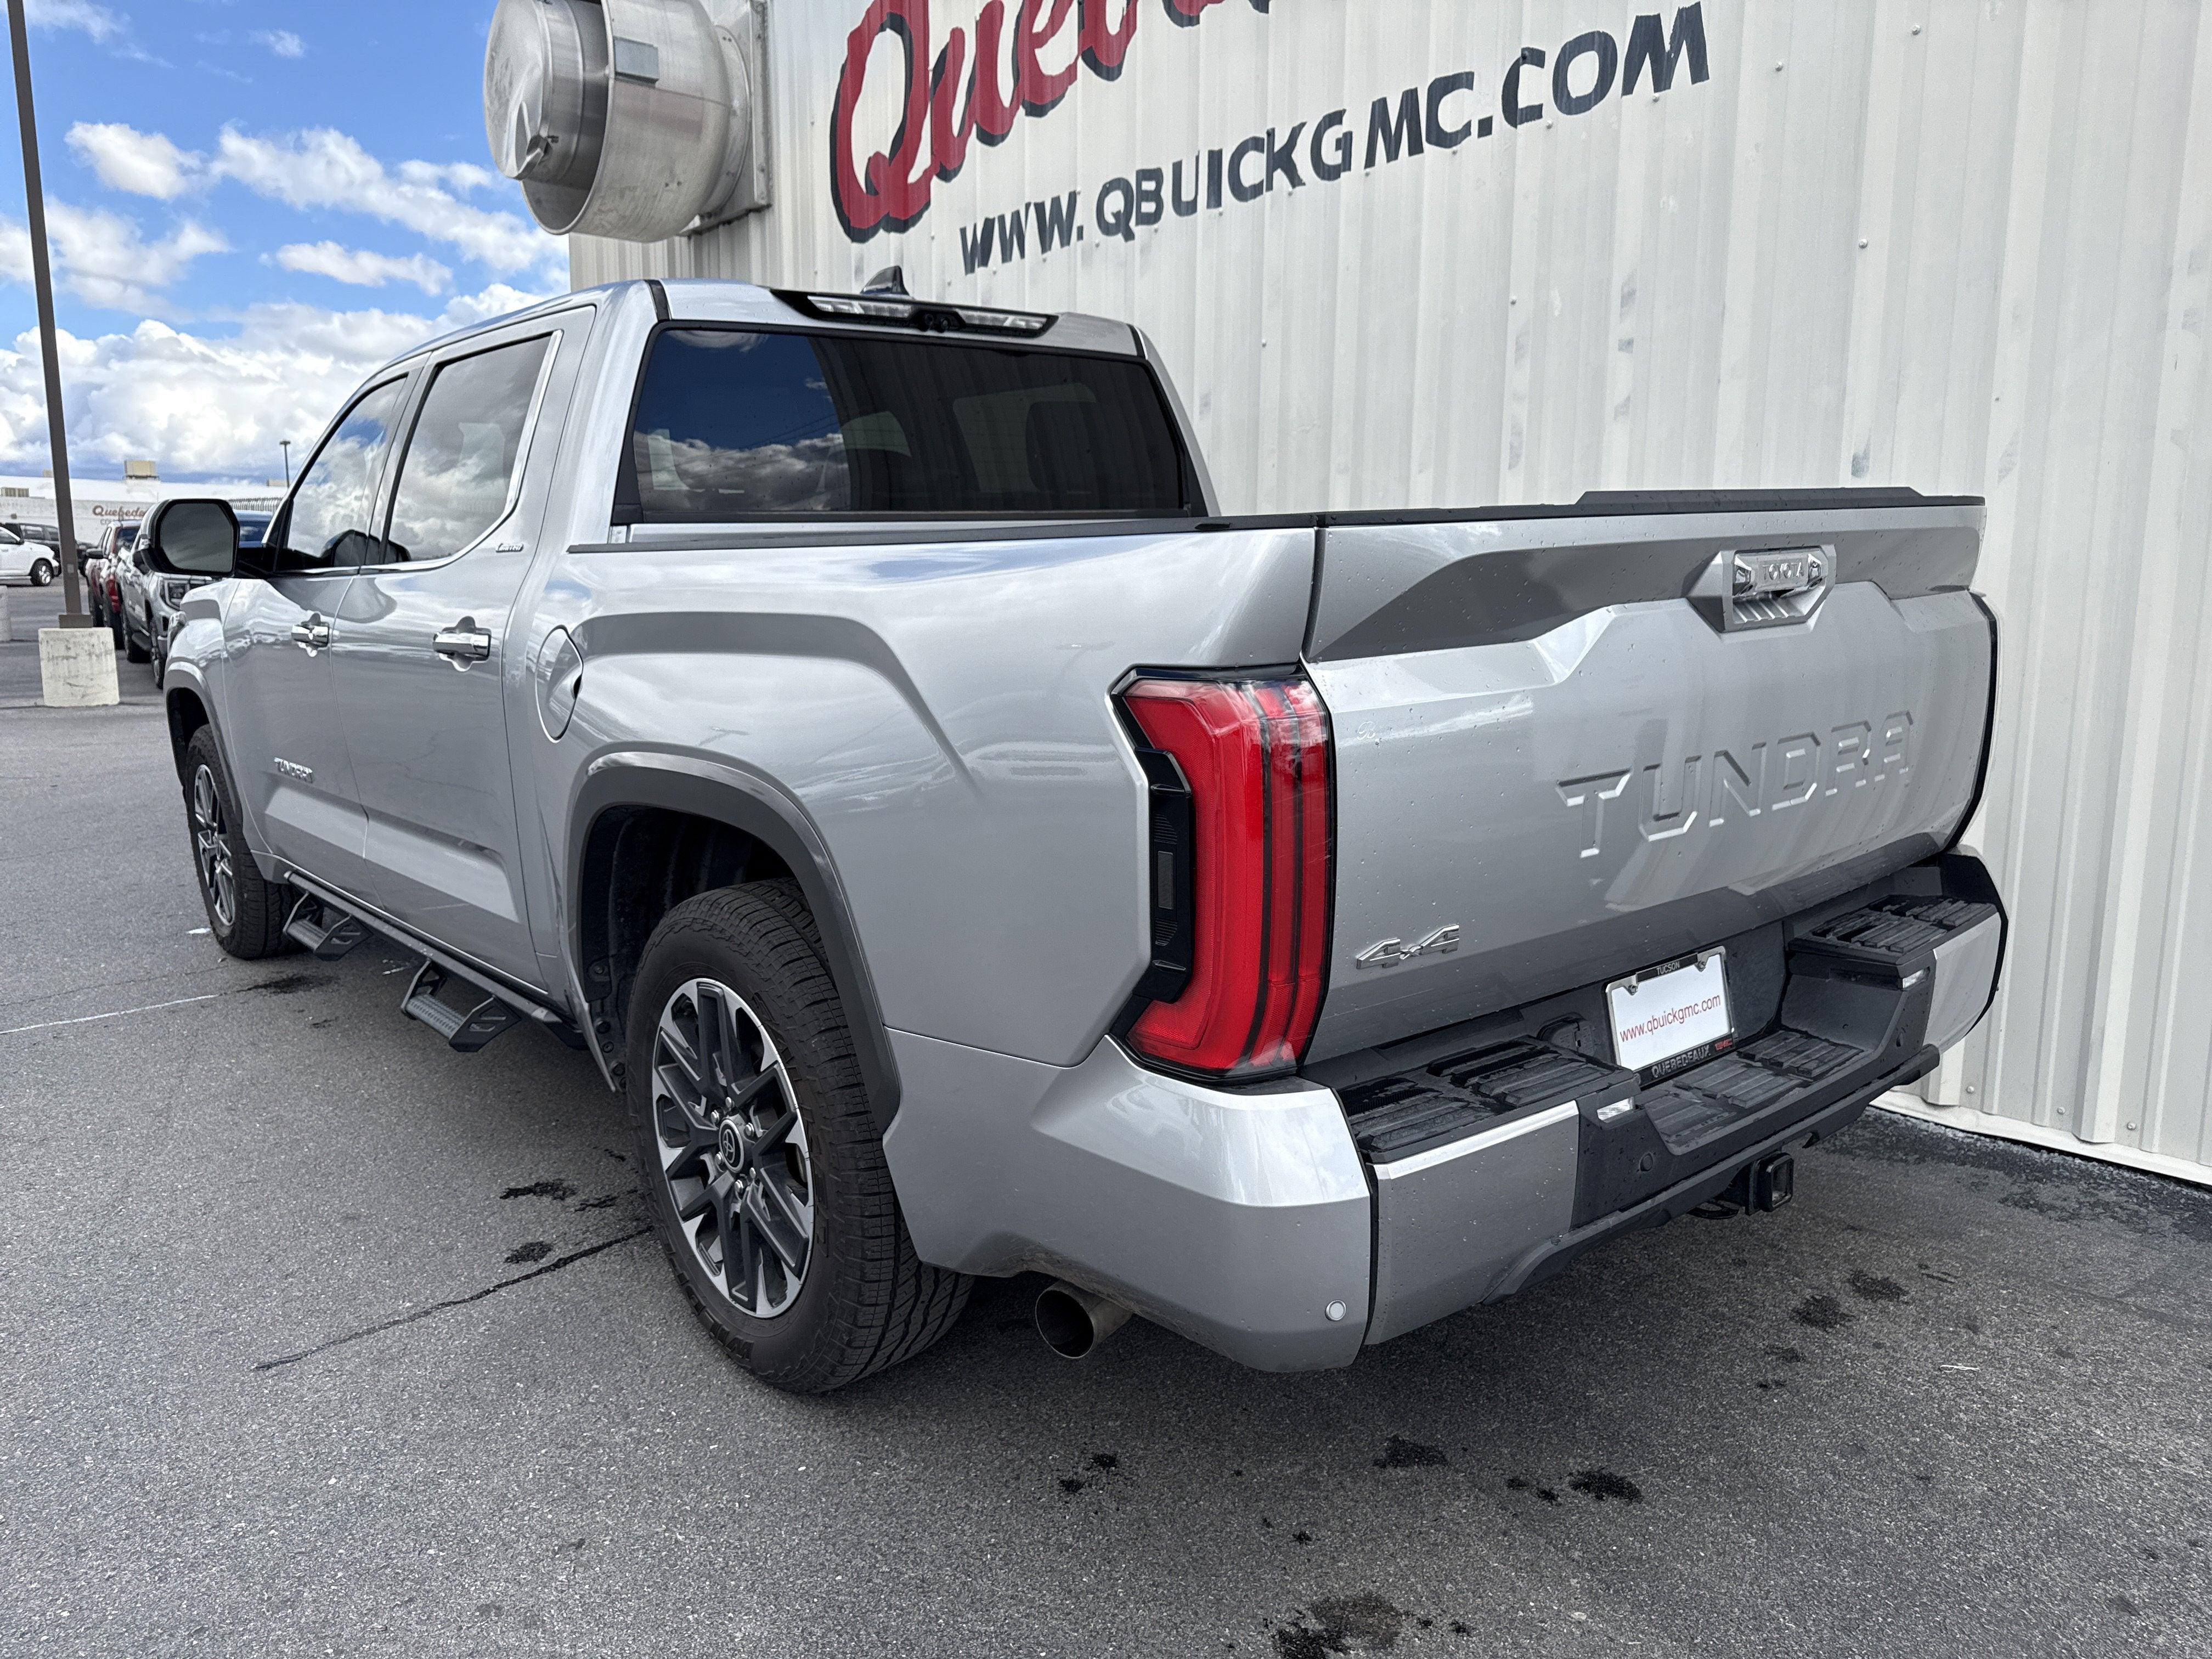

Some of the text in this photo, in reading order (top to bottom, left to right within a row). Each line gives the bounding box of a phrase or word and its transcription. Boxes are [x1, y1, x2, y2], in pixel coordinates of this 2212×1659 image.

[1762, 562, 1804, 580] TOYOTA
[1555, 711, 1913, 857] TUNDRA
[1656, 962, 1680, 975] TUCSON
[1620, 995, 1720, 1042] www.qbuickgmc.com
